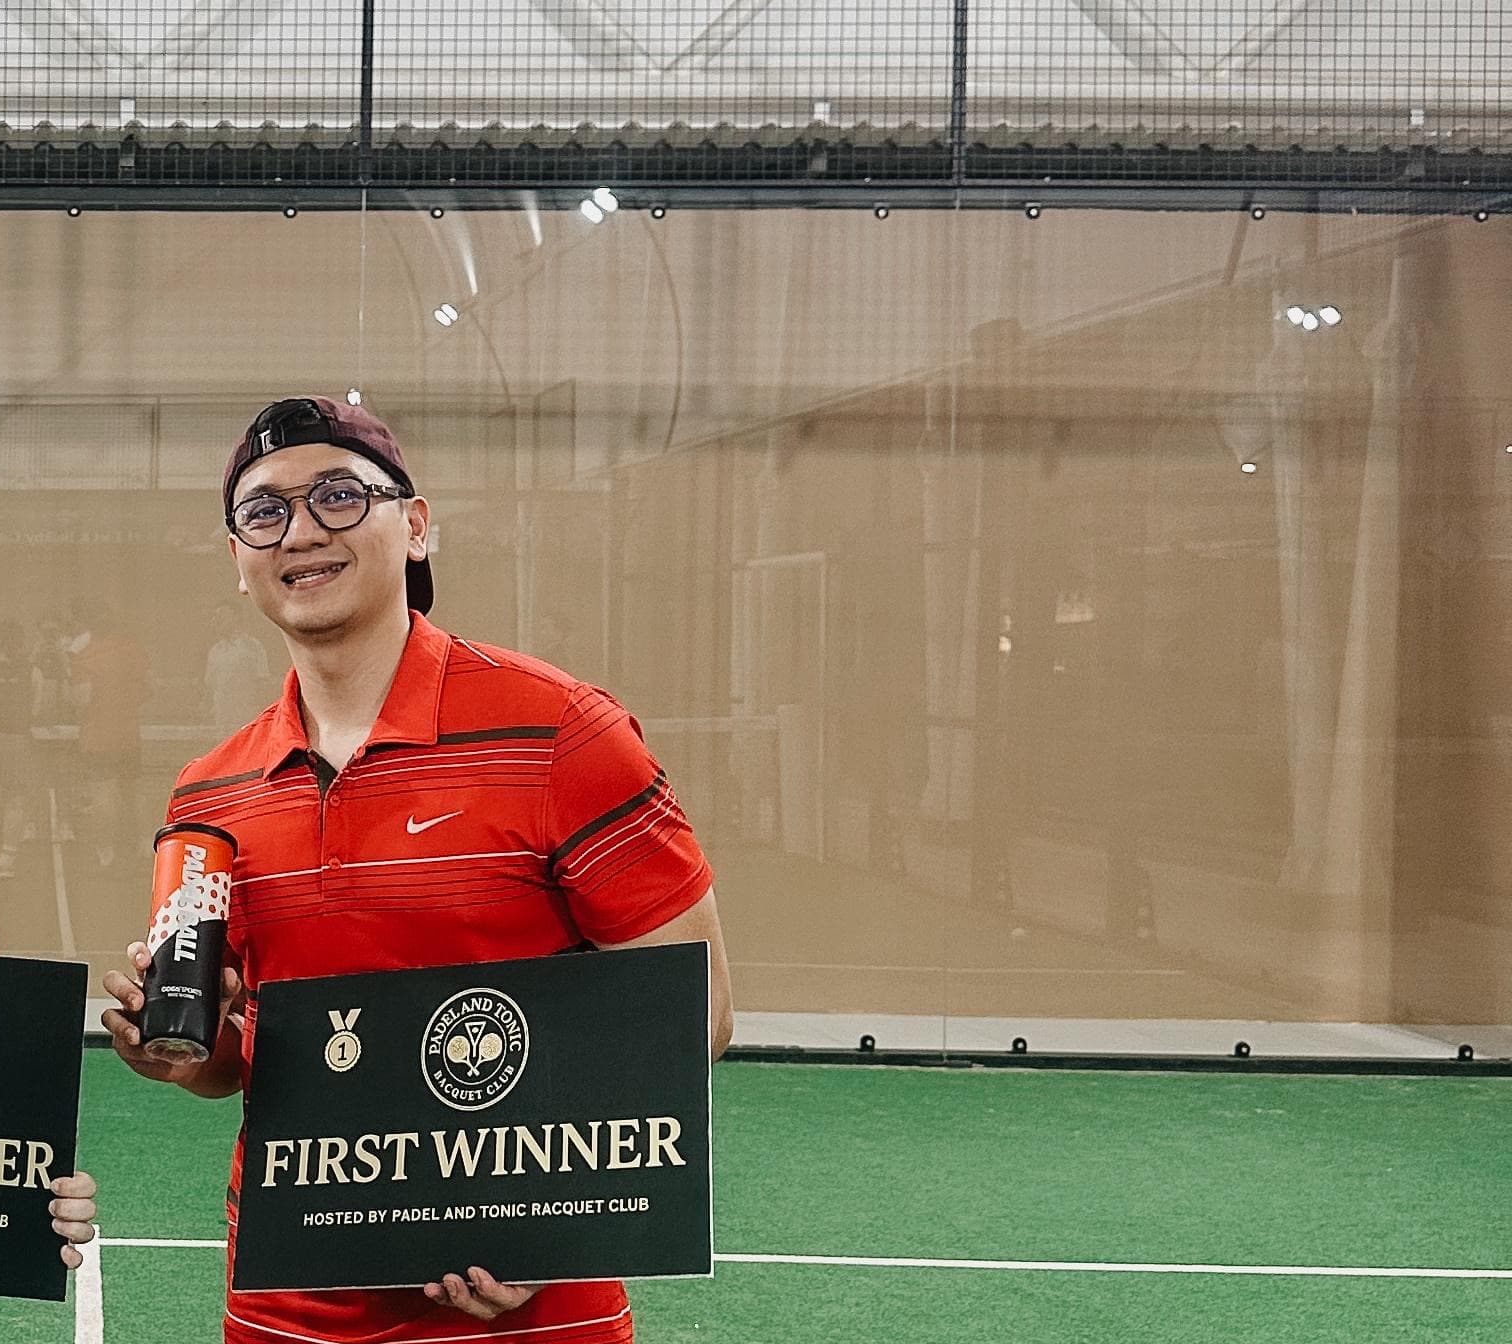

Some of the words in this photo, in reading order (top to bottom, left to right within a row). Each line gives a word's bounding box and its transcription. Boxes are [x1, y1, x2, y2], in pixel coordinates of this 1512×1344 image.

[428, 1007, 461, 1055] PADEL
[460, 997, 493, 1016] AND
[494, 1002, 522, 1052] TONIC
[337, 1041, 348, 1062] 1
[486, 1064, 516, 1096] CLUB
[261, 1132, 420, 1188] FIRST
[430, 1116, 687, 1178] WINNER
[303, 1210, 364, 1227] HOSTED
[368, 1209, 388, 1224] BY
[391, 1207, 441, 1223] PADEL
[443, 1205, 476, 1220] AND
[478, 1203, 527, 1219] TONIC
[531, 1199, 605, 1217] RACQUET
[608, 1197, 650, 1213] CLUB
